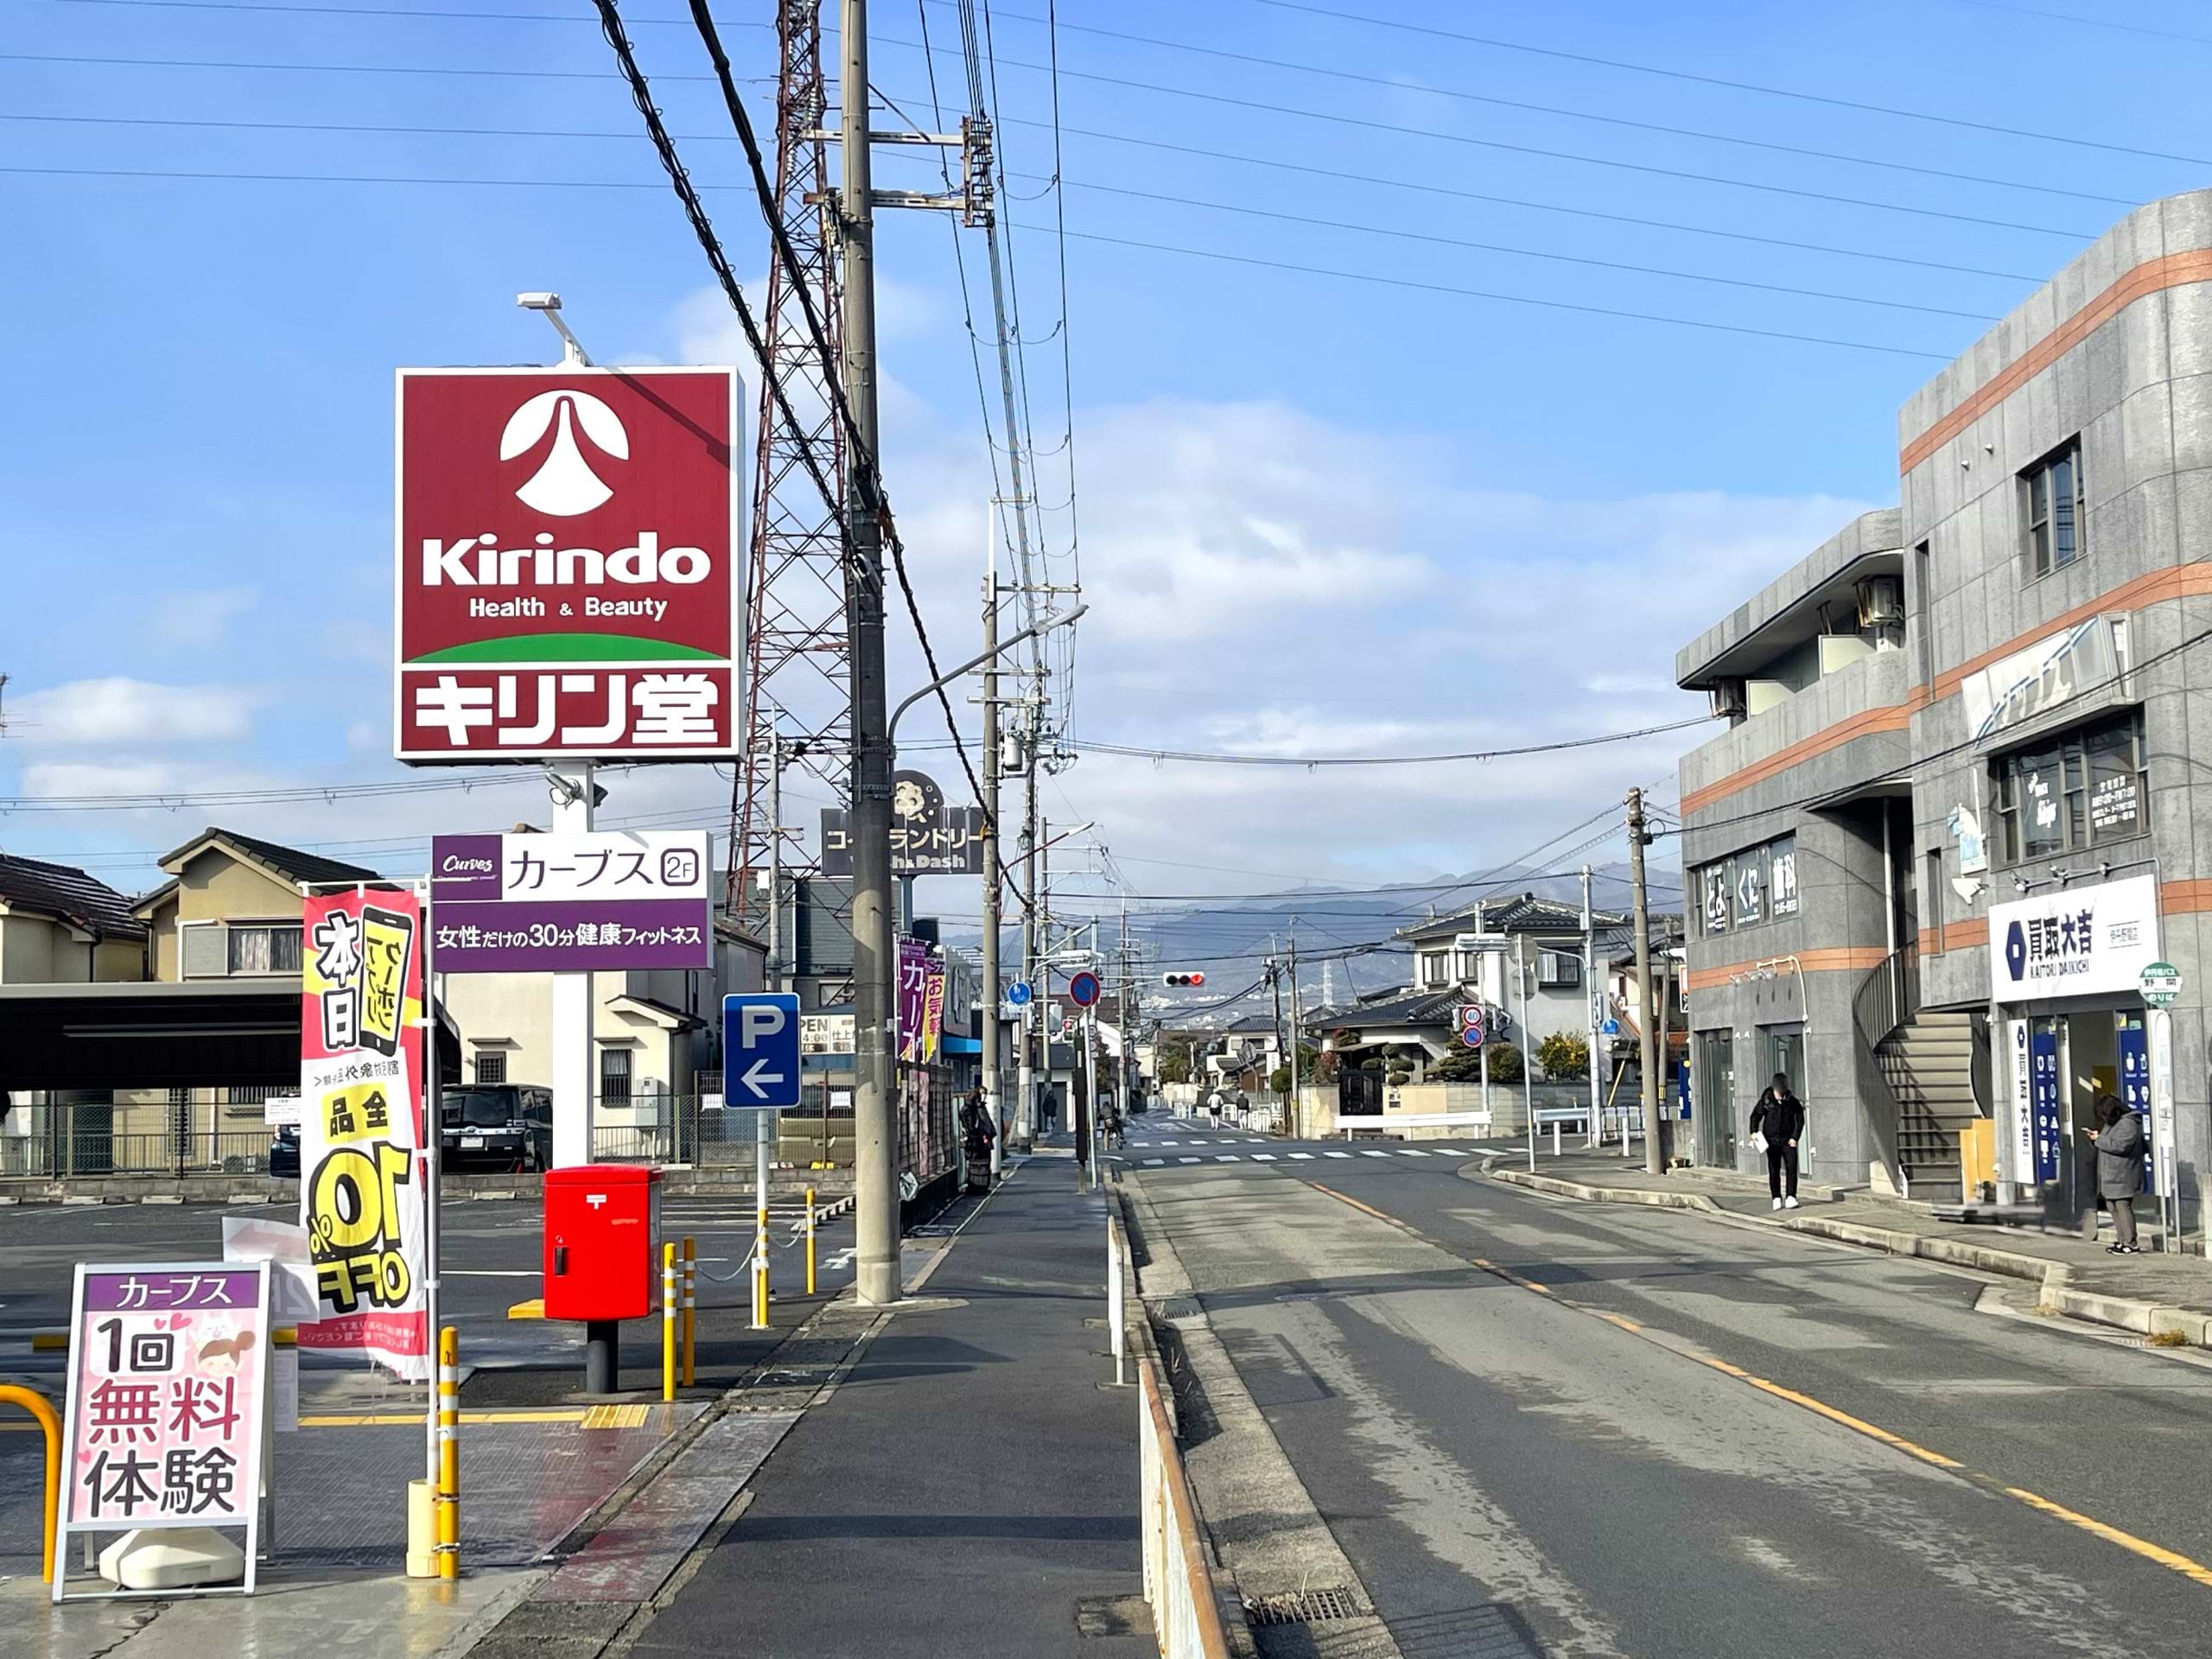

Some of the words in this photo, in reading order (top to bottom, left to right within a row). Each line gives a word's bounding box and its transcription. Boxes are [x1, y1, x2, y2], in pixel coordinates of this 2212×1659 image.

[423, 531, 711, 586] Kirindo
[470, 597, 544, 617] Health
[560, 603, 574, 616] &
[585, 597, 668, 621] Beauty
[416, 674, 718, 746] キリン堂
[828, 828, 983, 850] コランドリー
[442, 855, 493, 872] Curves
[508, 849, 654, 889] カーブス
[666, 856, 692, 878] 2F
[436, 923, 702, 949] 女性だけの30分健康フィットネス
[2028, 909, 2093, 963] 買取大吉
[741, 1005, 785, 1048] P
[118, 1276, 232, 1308] カーブス
[98, 1318, 174, 1373] 1回
[89, 1376, 240, 1444] 無料
[84, 1447, 237, 1518] 体験
